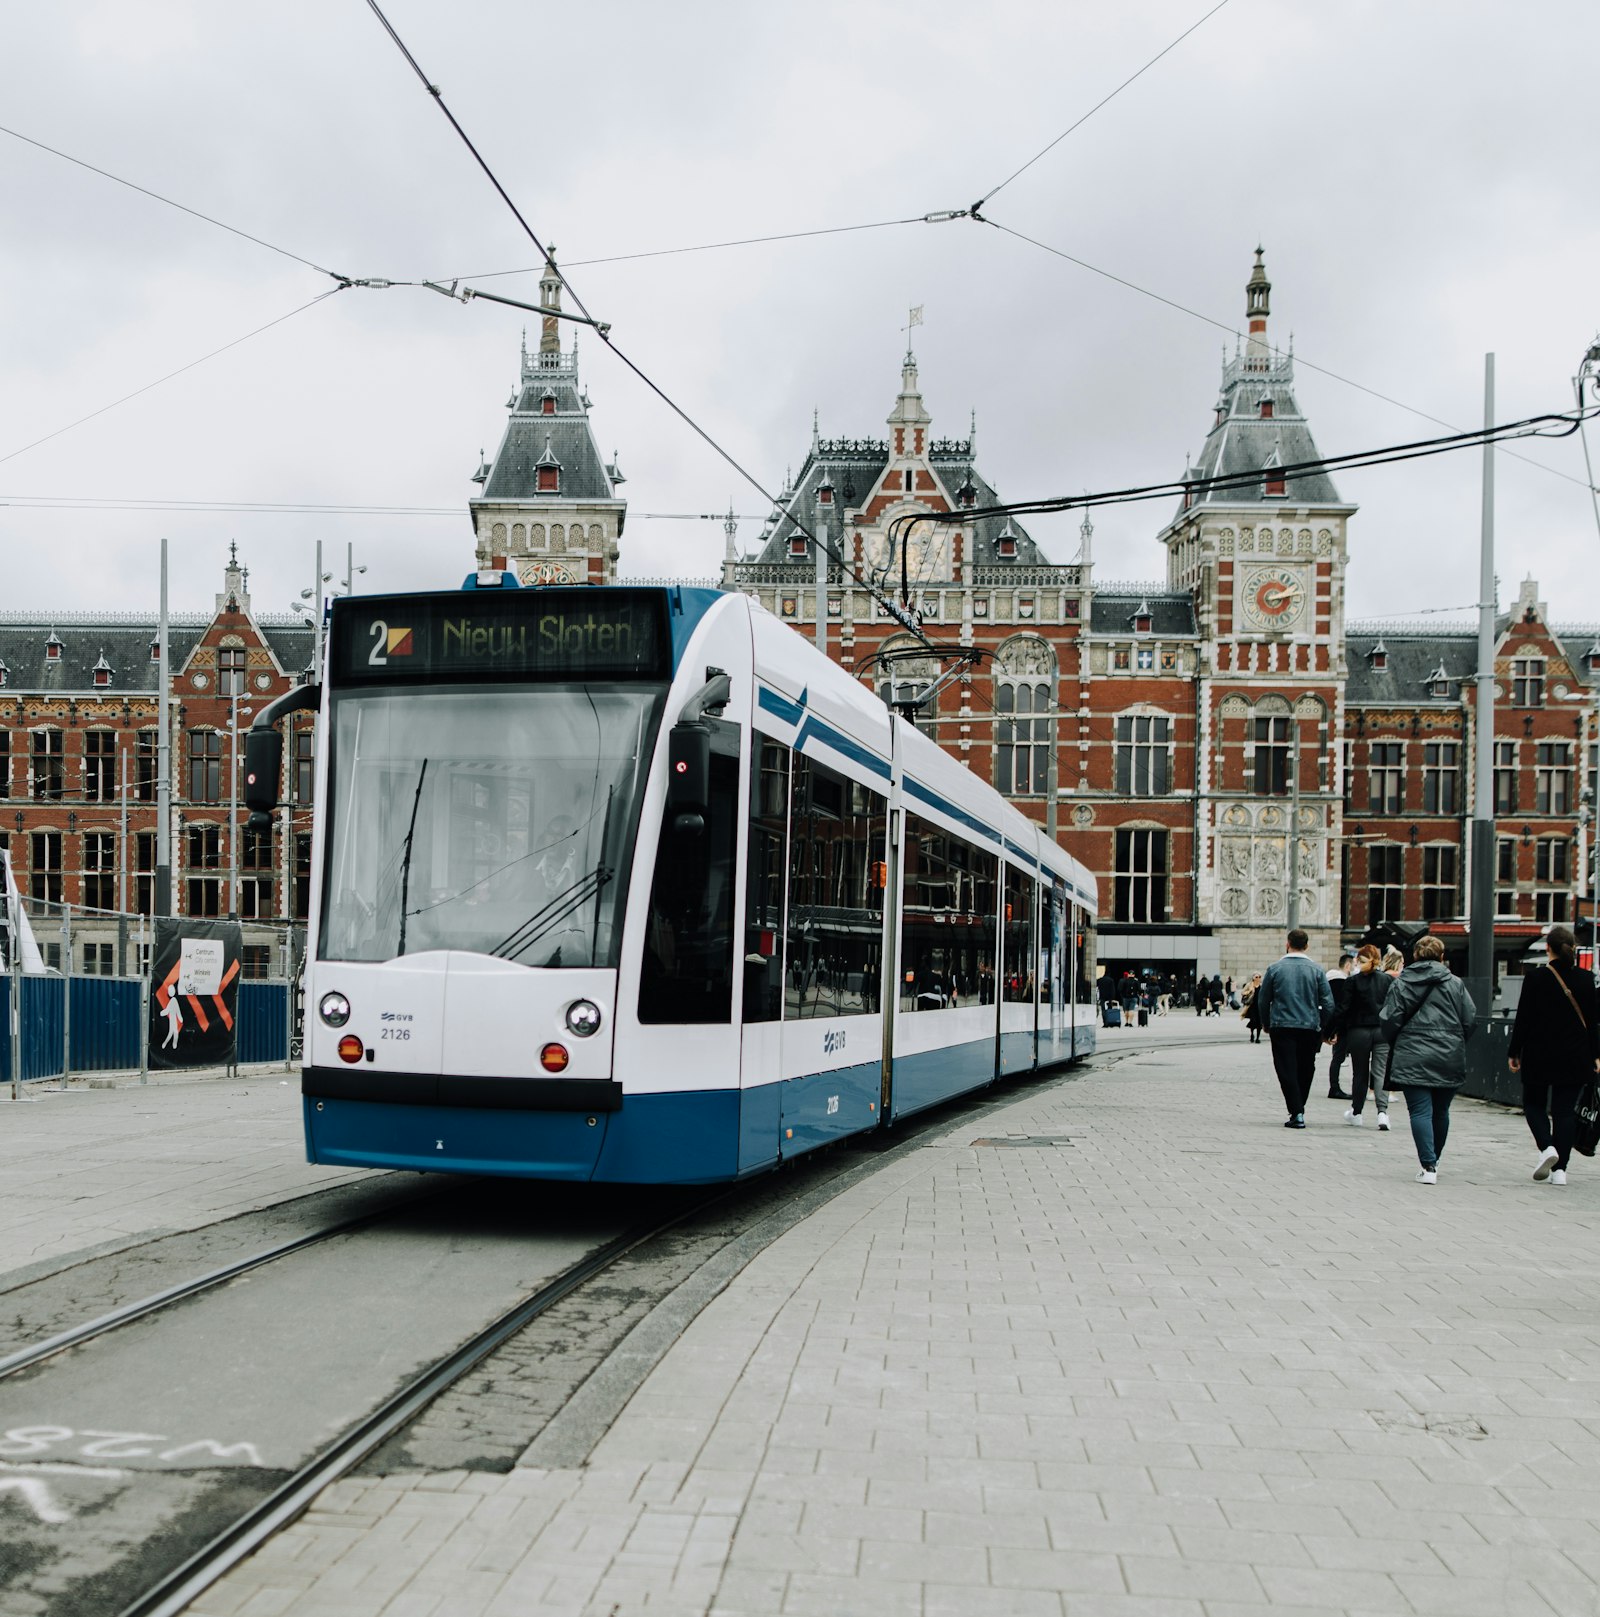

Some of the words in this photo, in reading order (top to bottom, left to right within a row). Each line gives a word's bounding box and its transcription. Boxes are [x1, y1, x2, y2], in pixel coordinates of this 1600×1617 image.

[368, 620, 388, 666] 2
[443, 618, 526, 656] Nieuw
[539, 614, 632, 655] Sloten
[195, 948, 215, 956] Centrum
[381, 1028, 411, 1041] 2126
[834, 1030, 846, 1050] GVB
